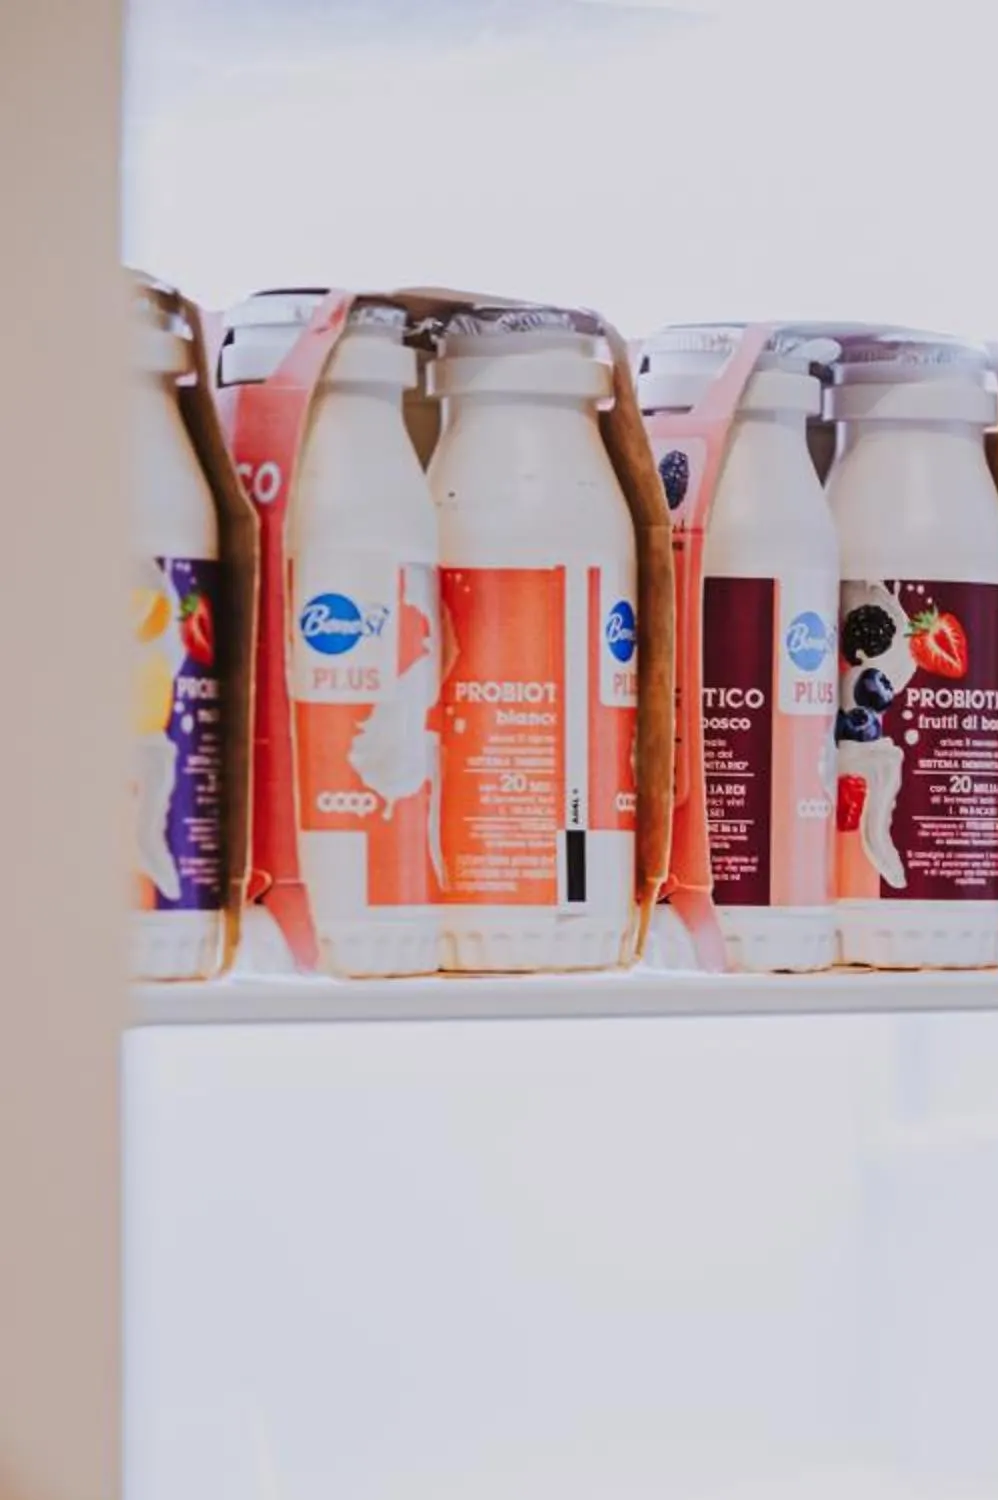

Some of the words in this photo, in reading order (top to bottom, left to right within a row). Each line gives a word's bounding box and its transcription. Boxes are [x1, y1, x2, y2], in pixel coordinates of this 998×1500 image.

[312, 667, 382, 690] PLUS
[455, 679, 557, 703] PROBIOT
[702, 687, 765, 709] TICO
[918, 713, 958, 729] frutti
[961, 714, 978, 730] di
[949, 775, 972, 794] 20
